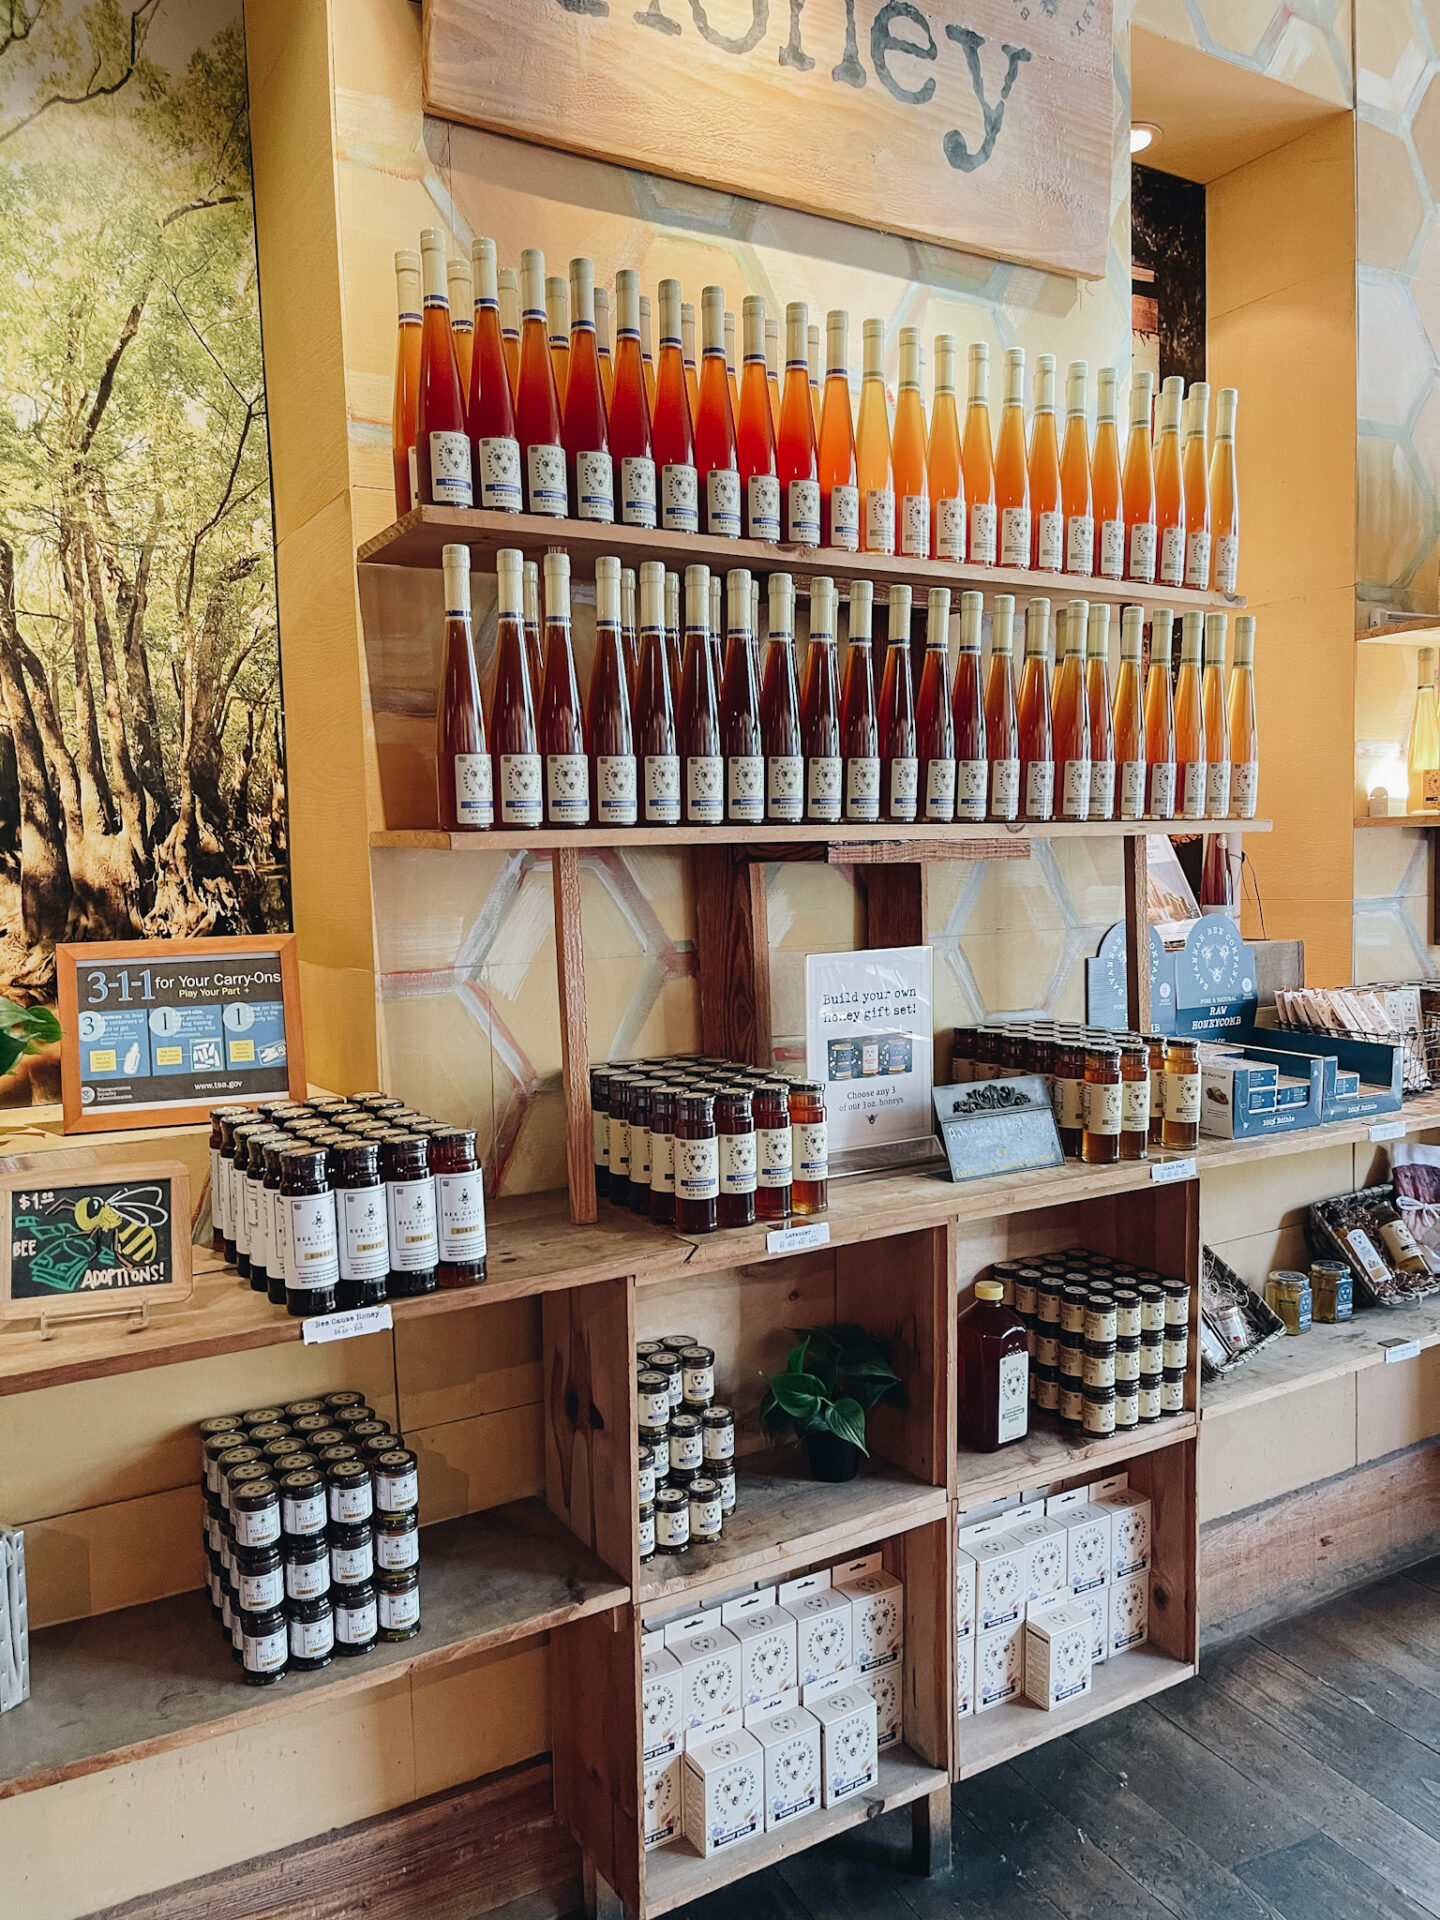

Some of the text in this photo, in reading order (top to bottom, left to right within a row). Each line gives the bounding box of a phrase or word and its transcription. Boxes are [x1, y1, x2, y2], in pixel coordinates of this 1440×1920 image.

[556, 0, 1032, 173] oney
[87, 969, 282, 1003] 3-1-1 for Your Carry-Ons
[179, 987, 241, 999] Play Your Part
[823, 988, 917, 1005] Build your own
[236, 1007, 242, 1026] 1
[864, 1006, 891, 1021] gift
[893, 1004, 917, 1015] set!
[1209, 1005, 1228, 1016] RAW
[82, 1016, 95, 1035] 3
[162, 1012, 168, 1030] 1
[1191, 1016, 1242, 1030] HONEYCOMB
[194, 1080, 243, 1090] www.tsa.gov
[847, 1086, 896, 1100] Choose any 3
[848, 1103, 860, 1111] our
[880, 1097, 905, 1107] honeys
[12, 1240, 37, 1257] BEE
[80, 1262, 165, 1289] ADOPTIONS!
[315, 1311, 380, 1328] Bee Cause Honey
